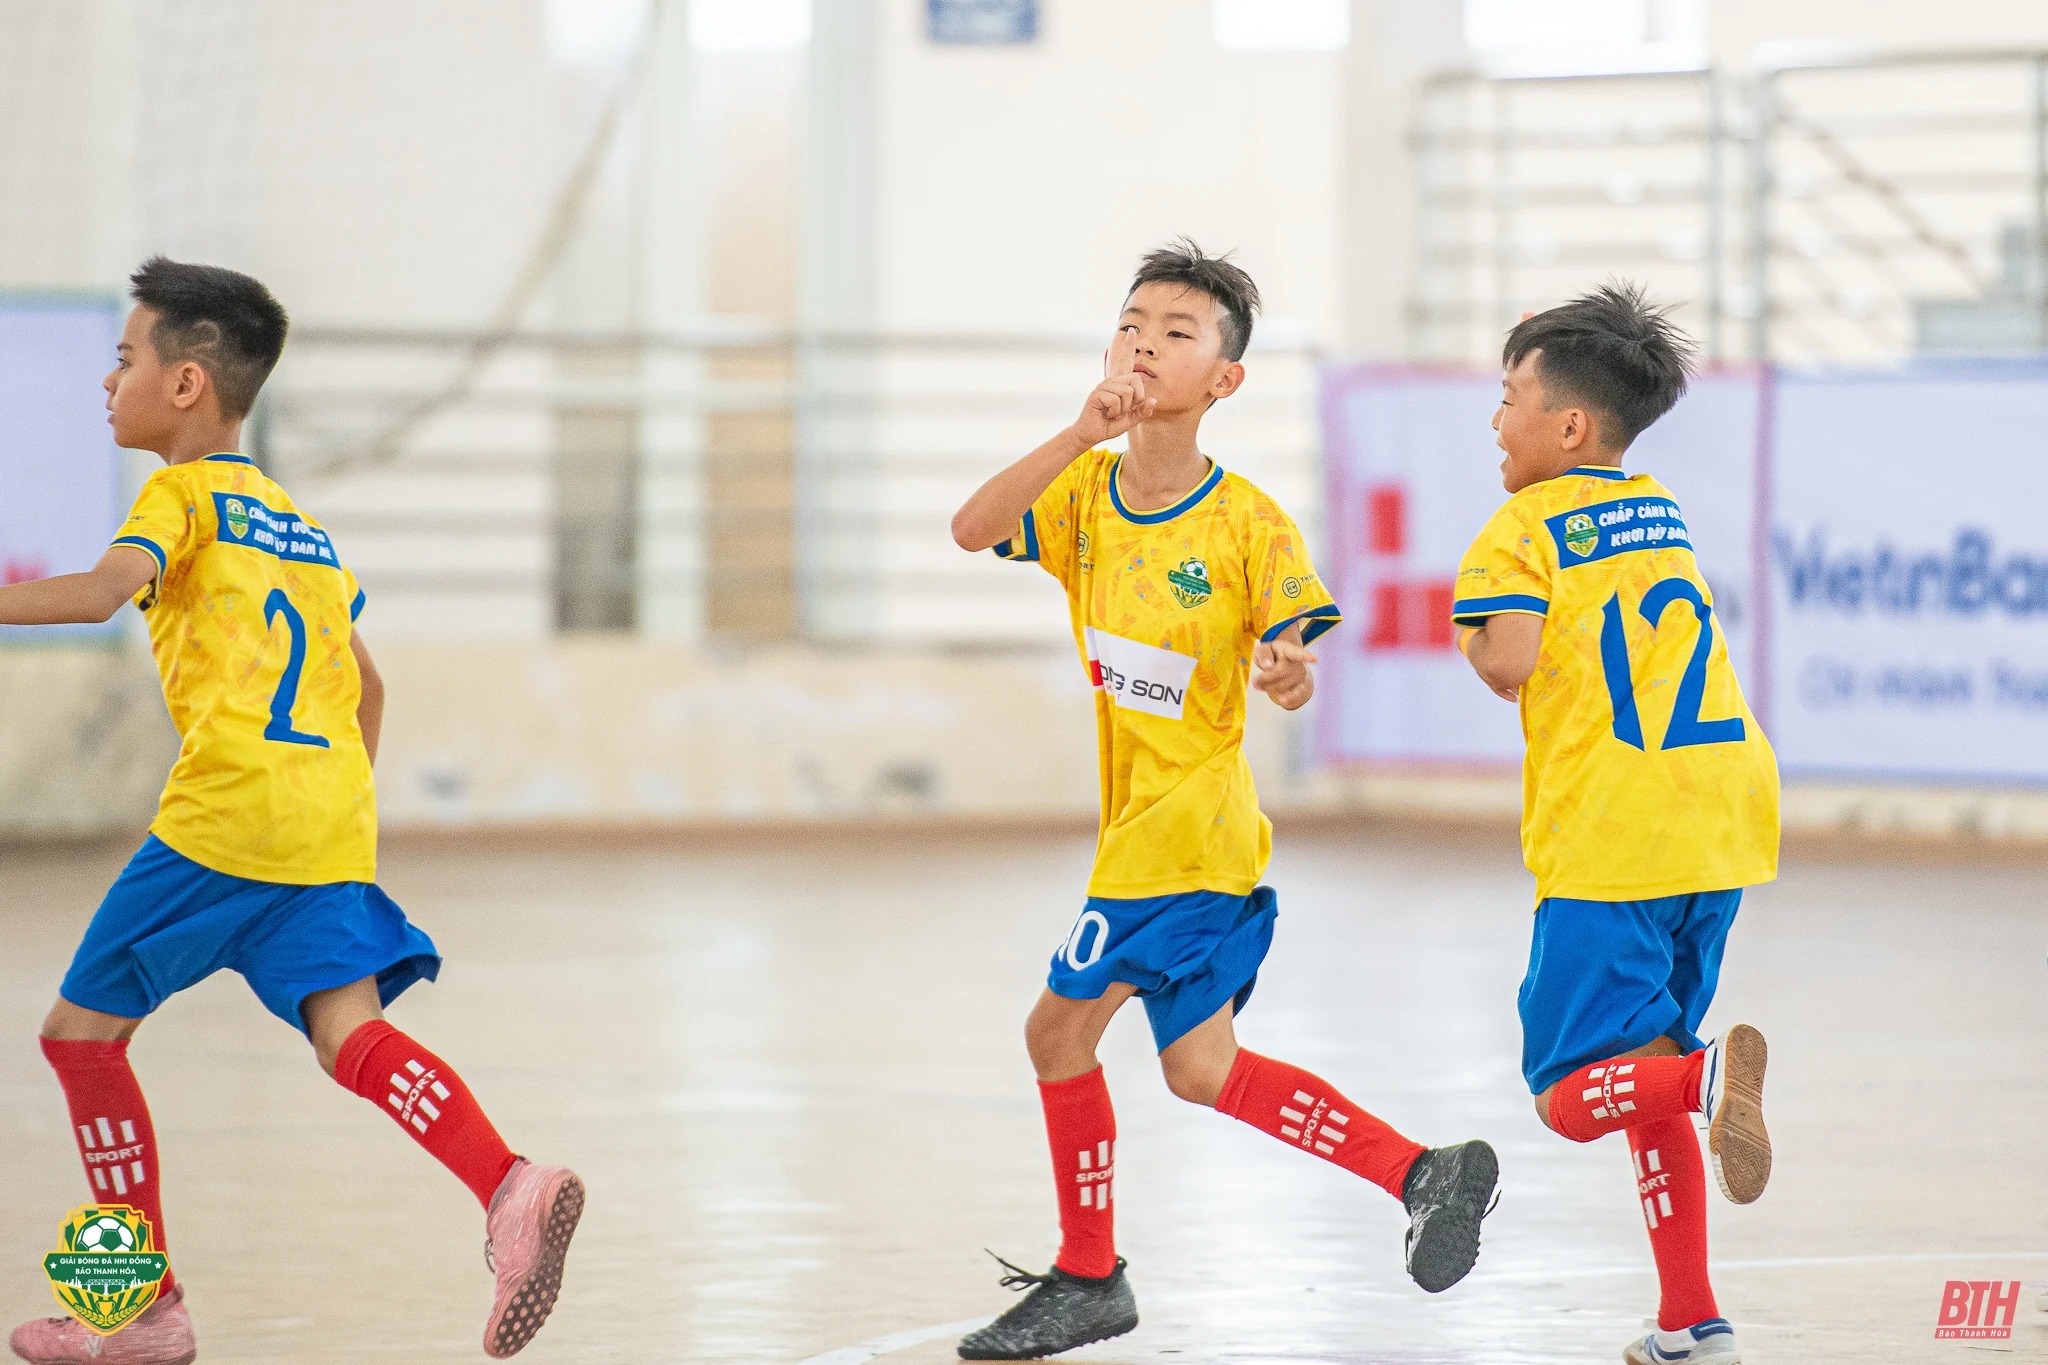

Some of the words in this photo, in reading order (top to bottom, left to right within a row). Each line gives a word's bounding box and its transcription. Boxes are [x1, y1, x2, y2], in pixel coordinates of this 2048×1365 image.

[263, 587, 331, 749] 2
[1100, 664, 1126, 691] ONG
[1130, 679, 1184, 706] SON
[1600, 577, 1746, 752] 12
[400, 1068, 437, 1123] SPORT
[1602, 1063, 1621, 1119] SPORT
[1301, 1097, 1329, 1148] SPORT
[84, 1144, 145, 1164] SPORT
[1639, 1173, 1672, 1194] ORT
